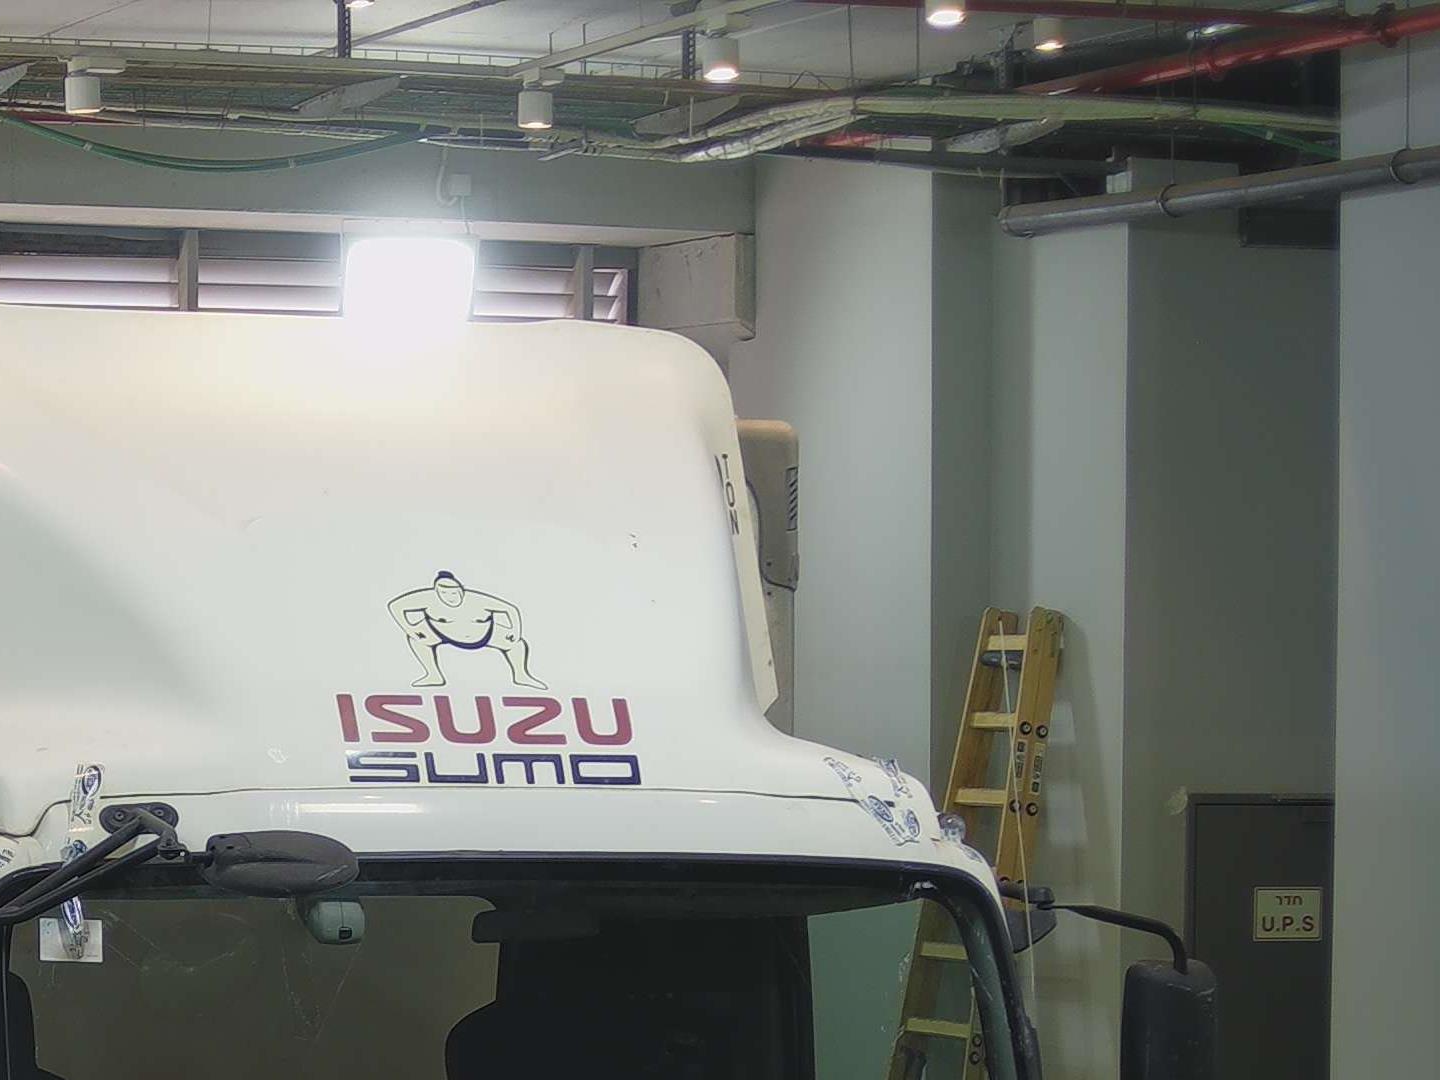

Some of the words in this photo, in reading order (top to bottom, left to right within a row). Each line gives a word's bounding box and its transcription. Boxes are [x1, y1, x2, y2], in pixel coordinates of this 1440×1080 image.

[336, 693, 633, 746] ISUZU
[345, 750, 642, 786] SUMO
[1275, 895, 1303, 907] חדר
[1262, 915, 1315, 932] U.P.S
